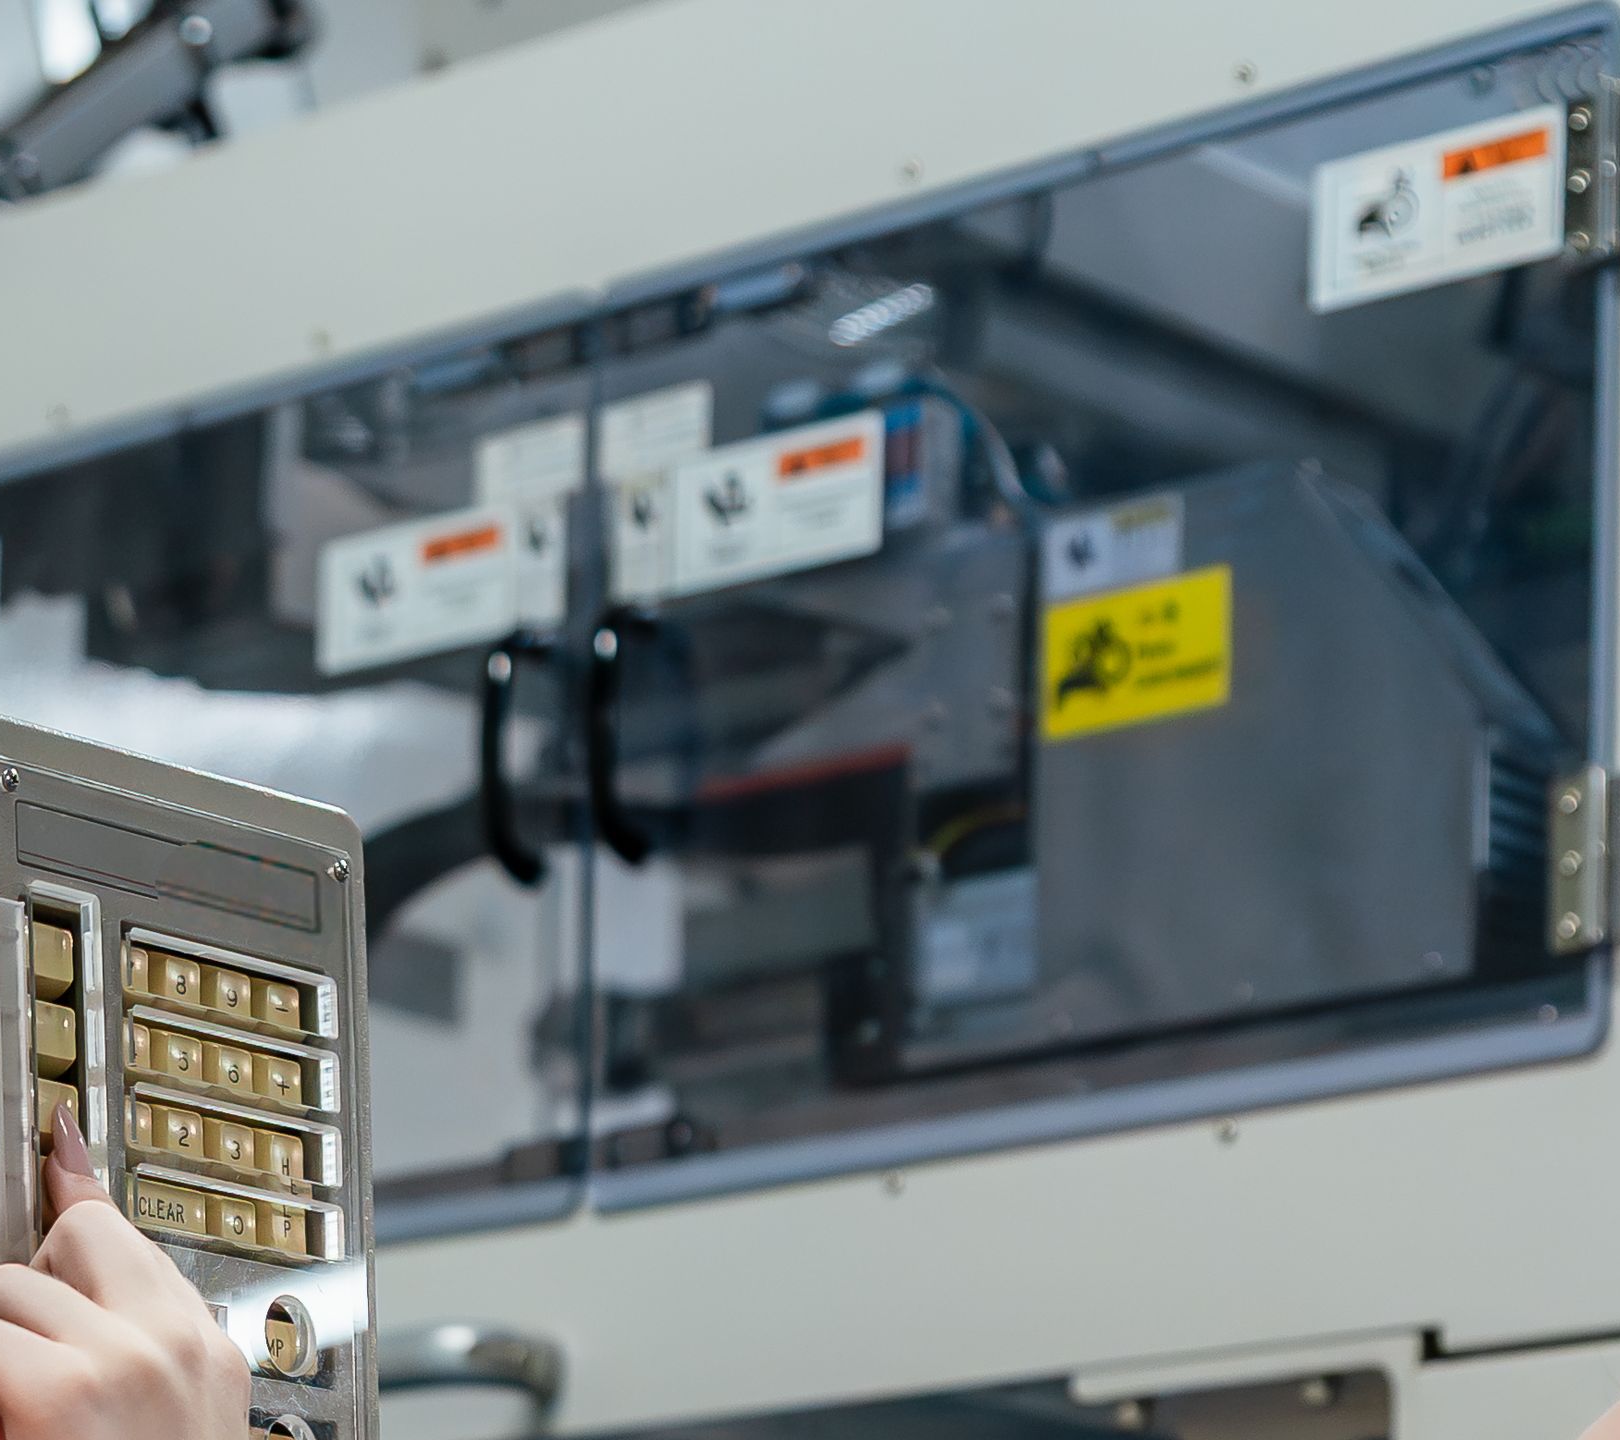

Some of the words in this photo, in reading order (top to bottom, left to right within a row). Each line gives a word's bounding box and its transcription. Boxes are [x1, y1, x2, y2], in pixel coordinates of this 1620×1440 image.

[176, 974, 187, 995] 8
[226, 988, 238, 1008] 9
[177, 1051, 190, 1072] 5
[228, 1064, 240, 1084] 6
[178, 1126, 190, 1148] 2
[230, 1140, 242, 1161] 3
[138, 1196, 186, 1225] CLEAR
